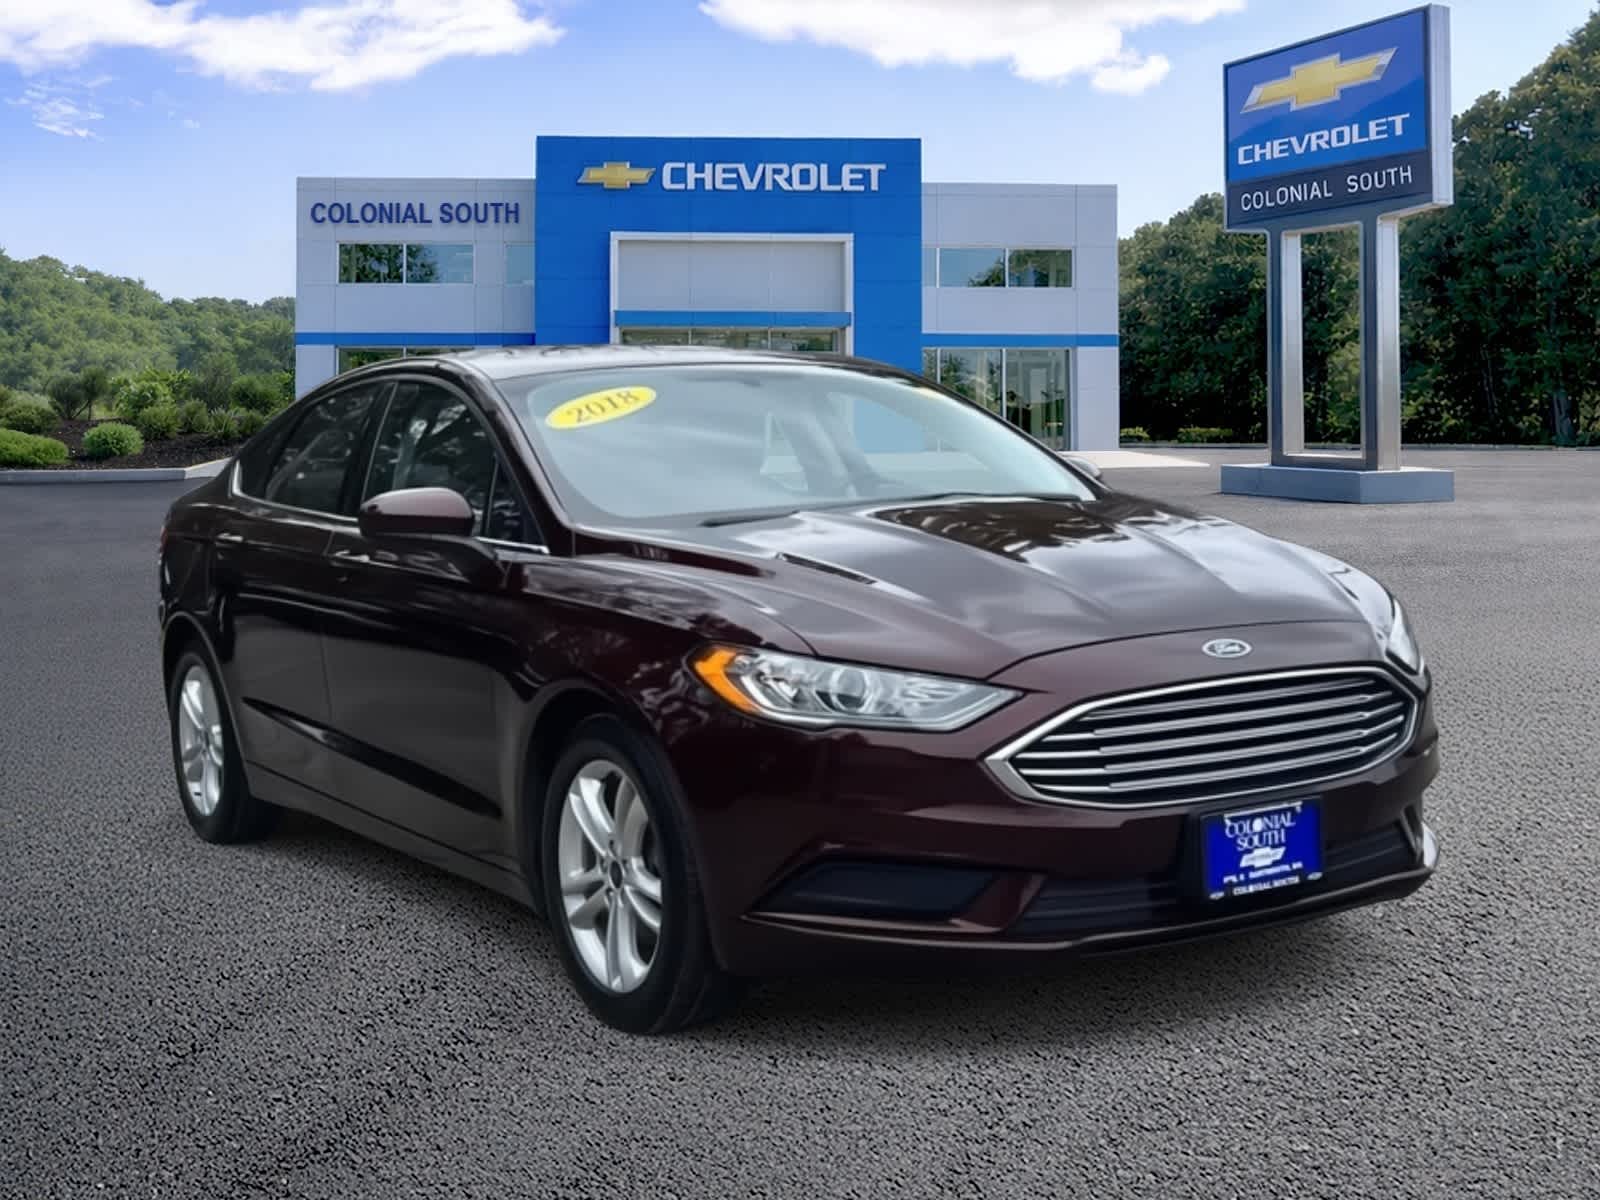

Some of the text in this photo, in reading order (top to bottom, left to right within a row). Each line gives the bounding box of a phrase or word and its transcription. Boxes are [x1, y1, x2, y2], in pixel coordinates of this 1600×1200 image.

[1238, 113, 1410, 165] CHEVROLET
[662, 162, 887, 191] CHEVROLET
[1241, 165, 1413, 211] COLONIAL SOUTH
[310, 202, 520, 224] COLONIAL SOUTH
[564, 390, 640, 423] 2018
[1224, 812, 1296, 838] COLONIAL
[1236, 828, 1286, 851] SOUTH
